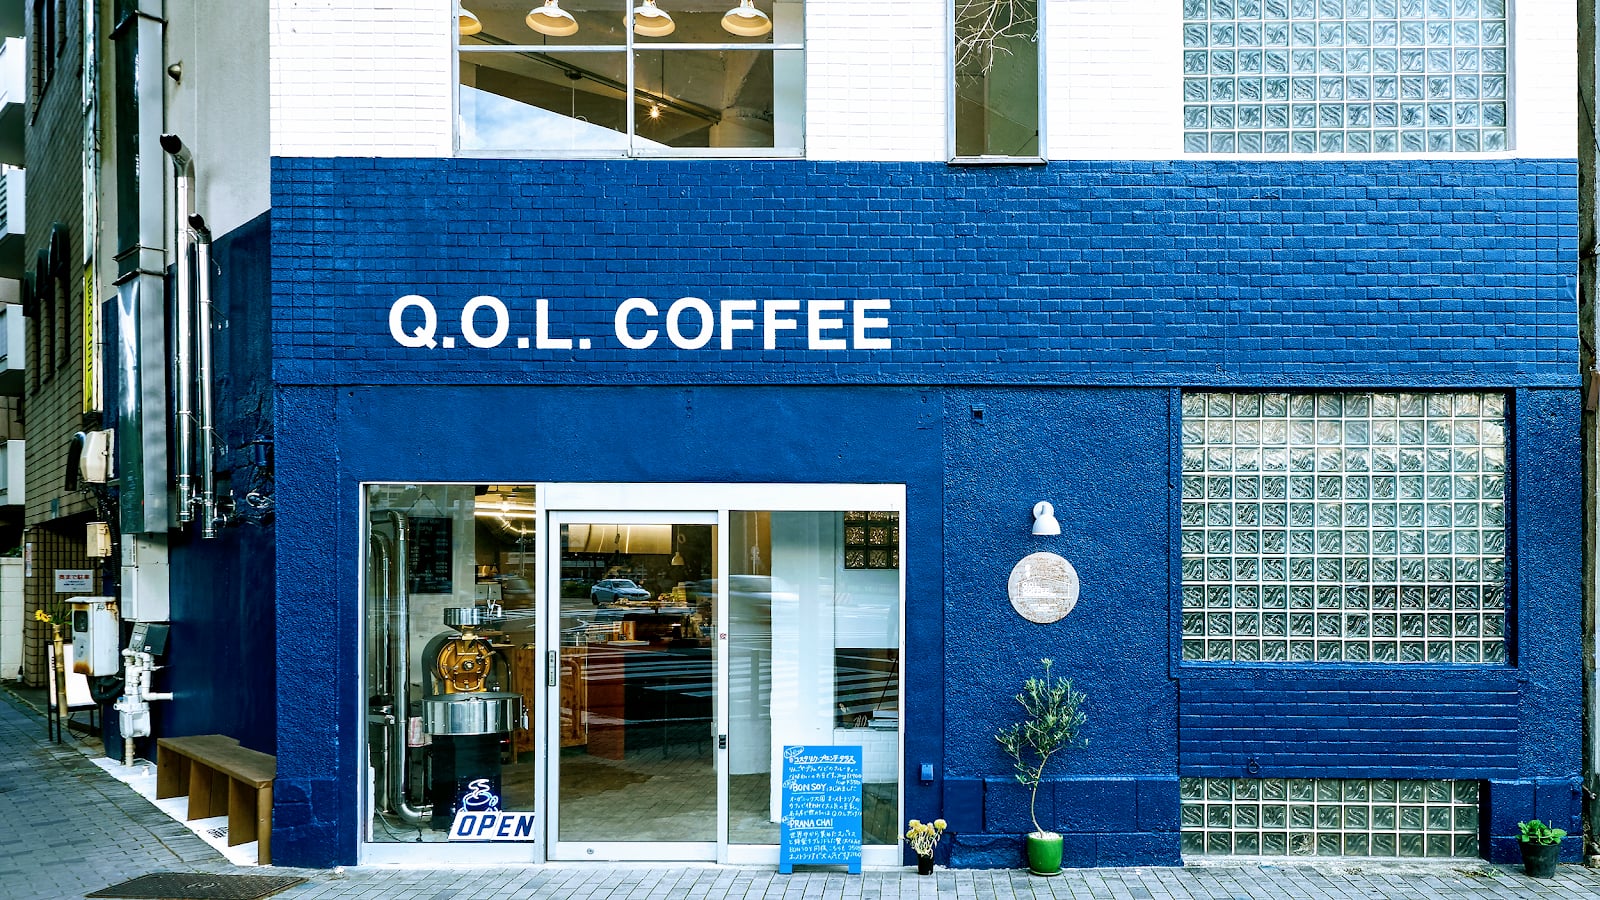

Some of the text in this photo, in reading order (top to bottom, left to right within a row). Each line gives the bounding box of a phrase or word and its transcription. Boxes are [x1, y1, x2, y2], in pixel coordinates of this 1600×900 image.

[388, 295, 892, 351] Q.O.L. COFFEE
[793, 783, 810, 792] BON
[811, 783, 827, 792] SOY
[456, 814, 535, 837] OPEN
[789, 819, 815, 828] PRANA
[815, 818, 834, 827] CHAI
